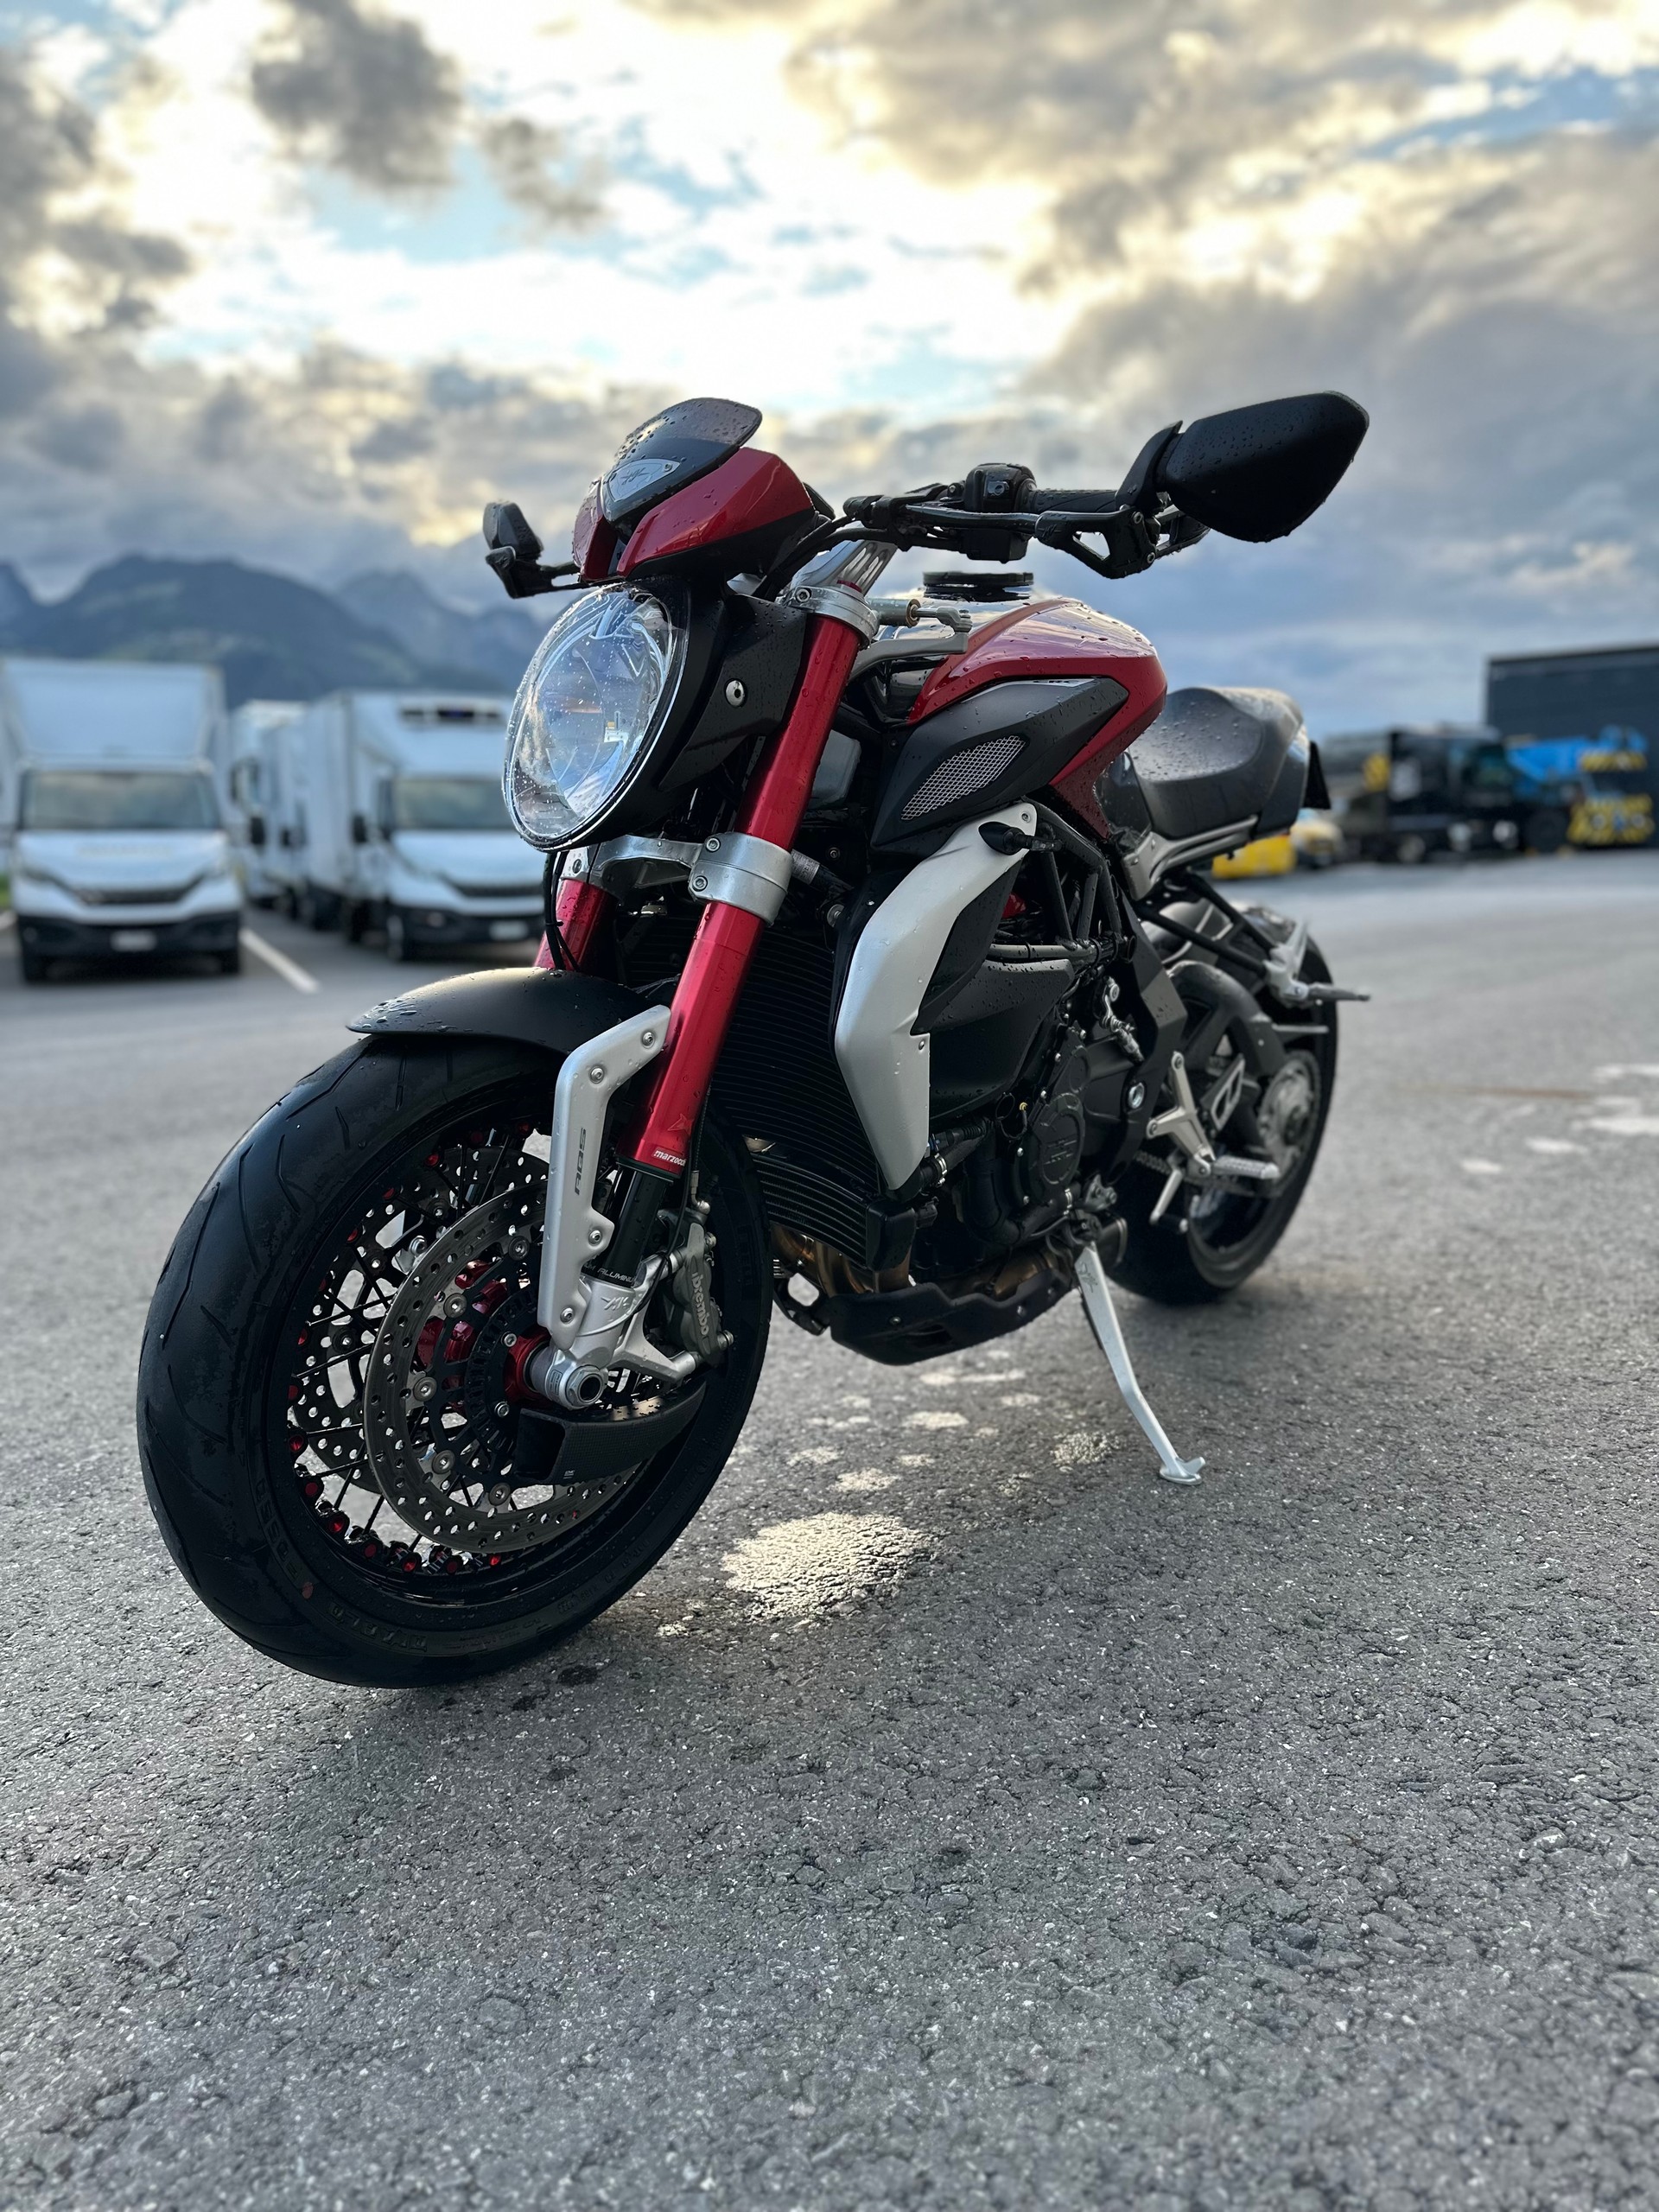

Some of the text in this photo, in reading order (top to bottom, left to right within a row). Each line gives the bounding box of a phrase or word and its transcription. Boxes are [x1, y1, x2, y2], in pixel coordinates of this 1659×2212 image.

[574, 1127, 587, 1196] ABS
[597, 1267, 634, 1283] ALUMINU
[690, 1274, 710, 1337] brembo
